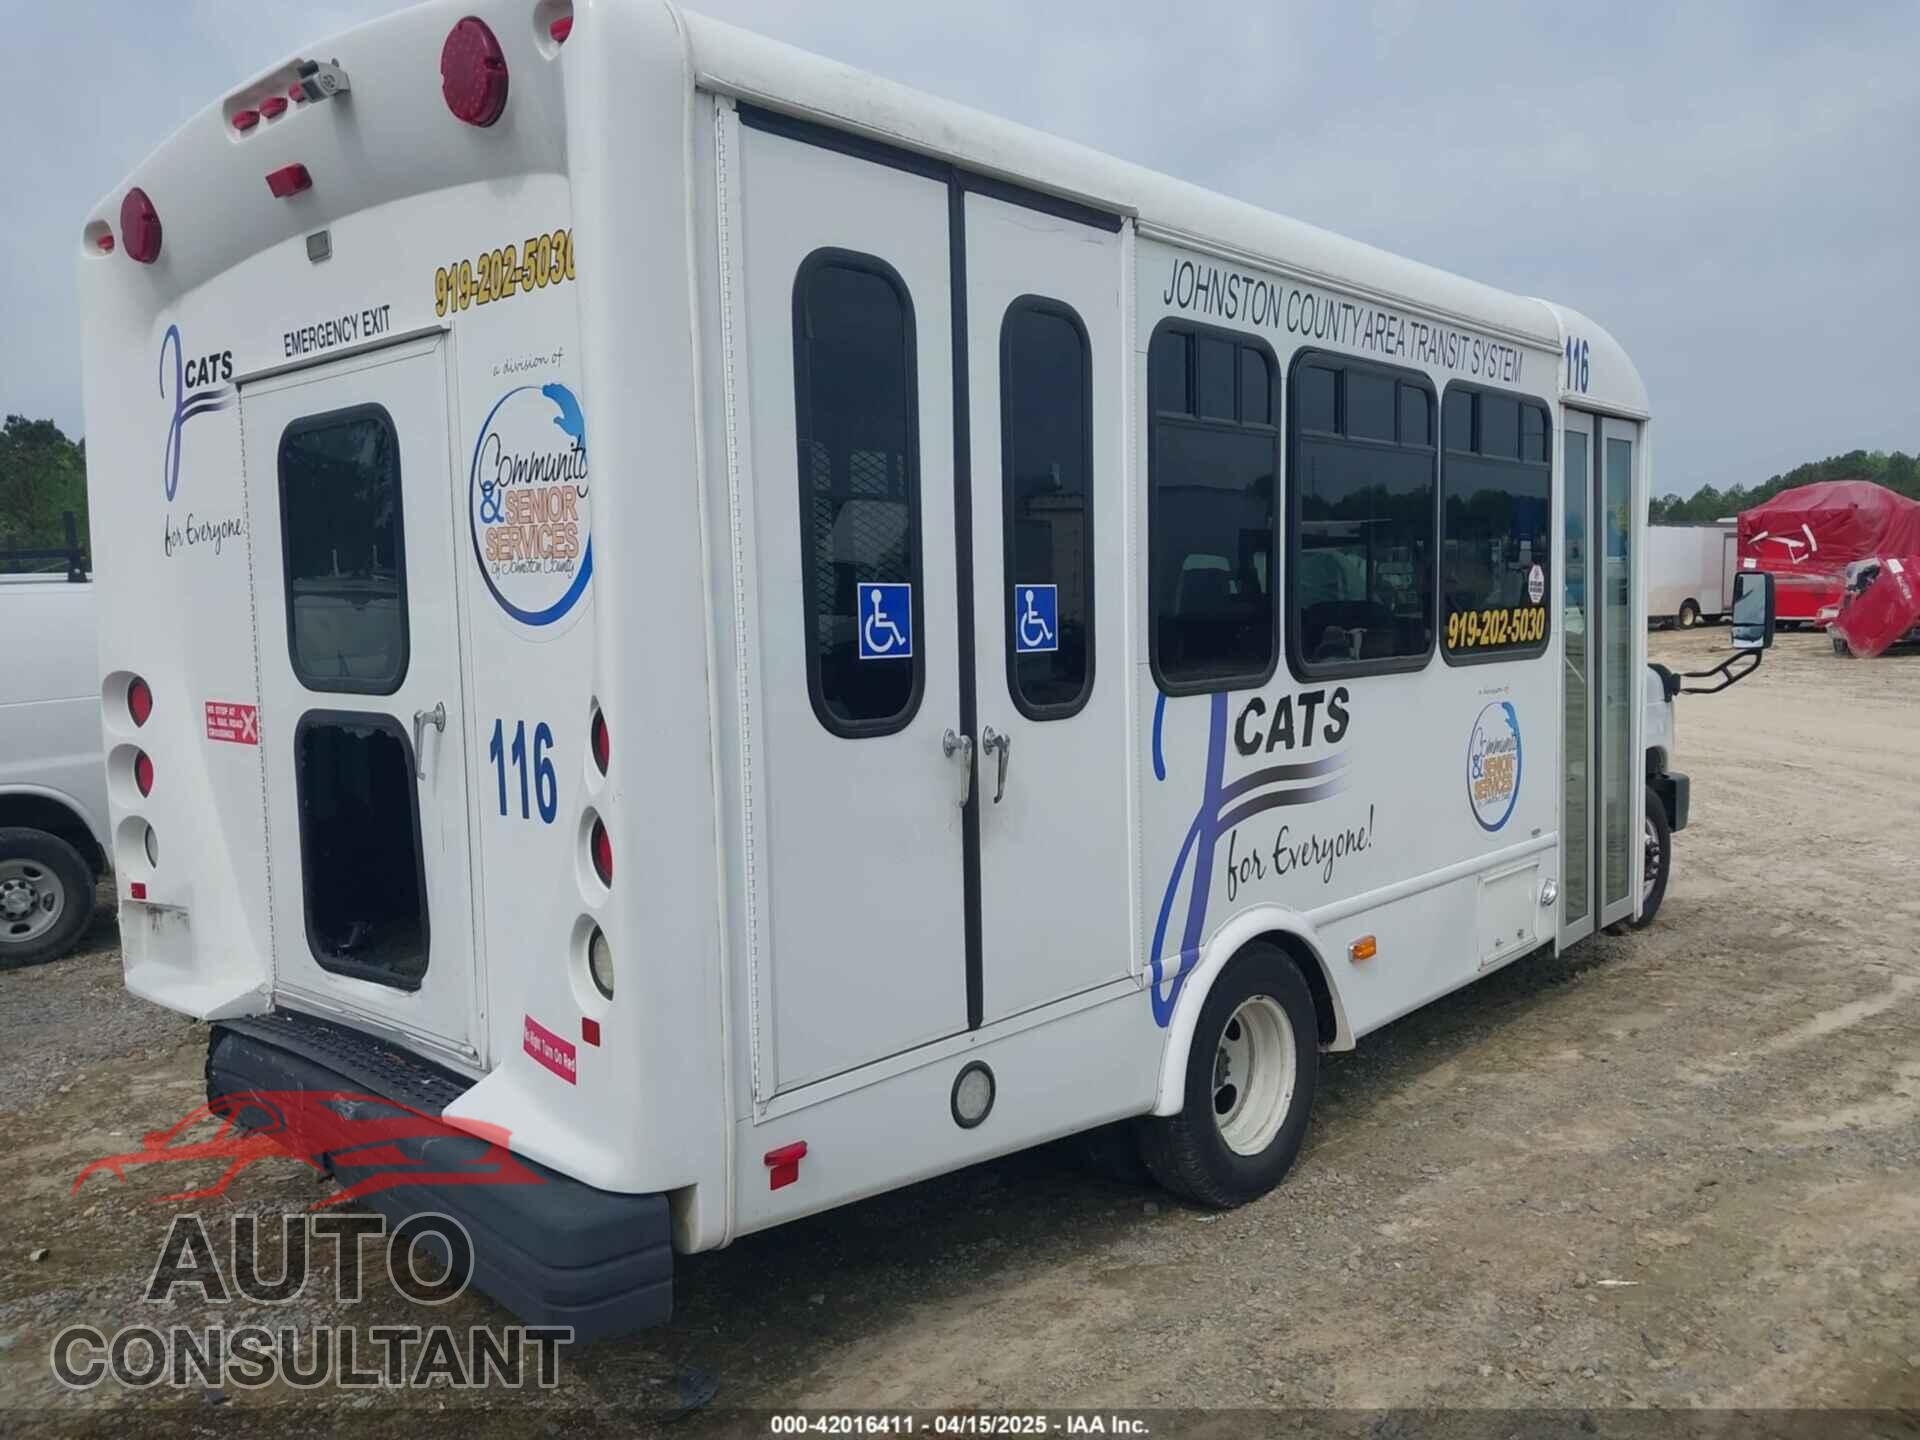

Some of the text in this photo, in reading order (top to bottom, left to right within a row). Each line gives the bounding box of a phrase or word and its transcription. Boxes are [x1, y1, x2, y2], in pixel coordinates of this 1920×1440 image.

[283, 304, 391, 358] EMERGENCY EXIT
[1164, 259, 1525, 384] JOHNSTON COUNTY AREA TRANSIT SYSTEM
[503, 353, 549, 375] division
[551, 346, 565, 368] of
[1566, 336, 1590, 394] 116
[479, 432, 590, 499] Community
[504, 484, 579, 526] SENIOR
[165, 513, 184, 557] for
[485, 521, 580, 562] SERVICES
[1446, 607, 1547, 649] 919-202-5030
[1233, 686, 1350, 756] CATS
[489, 718, 558, 825] 116
[1227, 803, 1375, 902] for Everyone!
